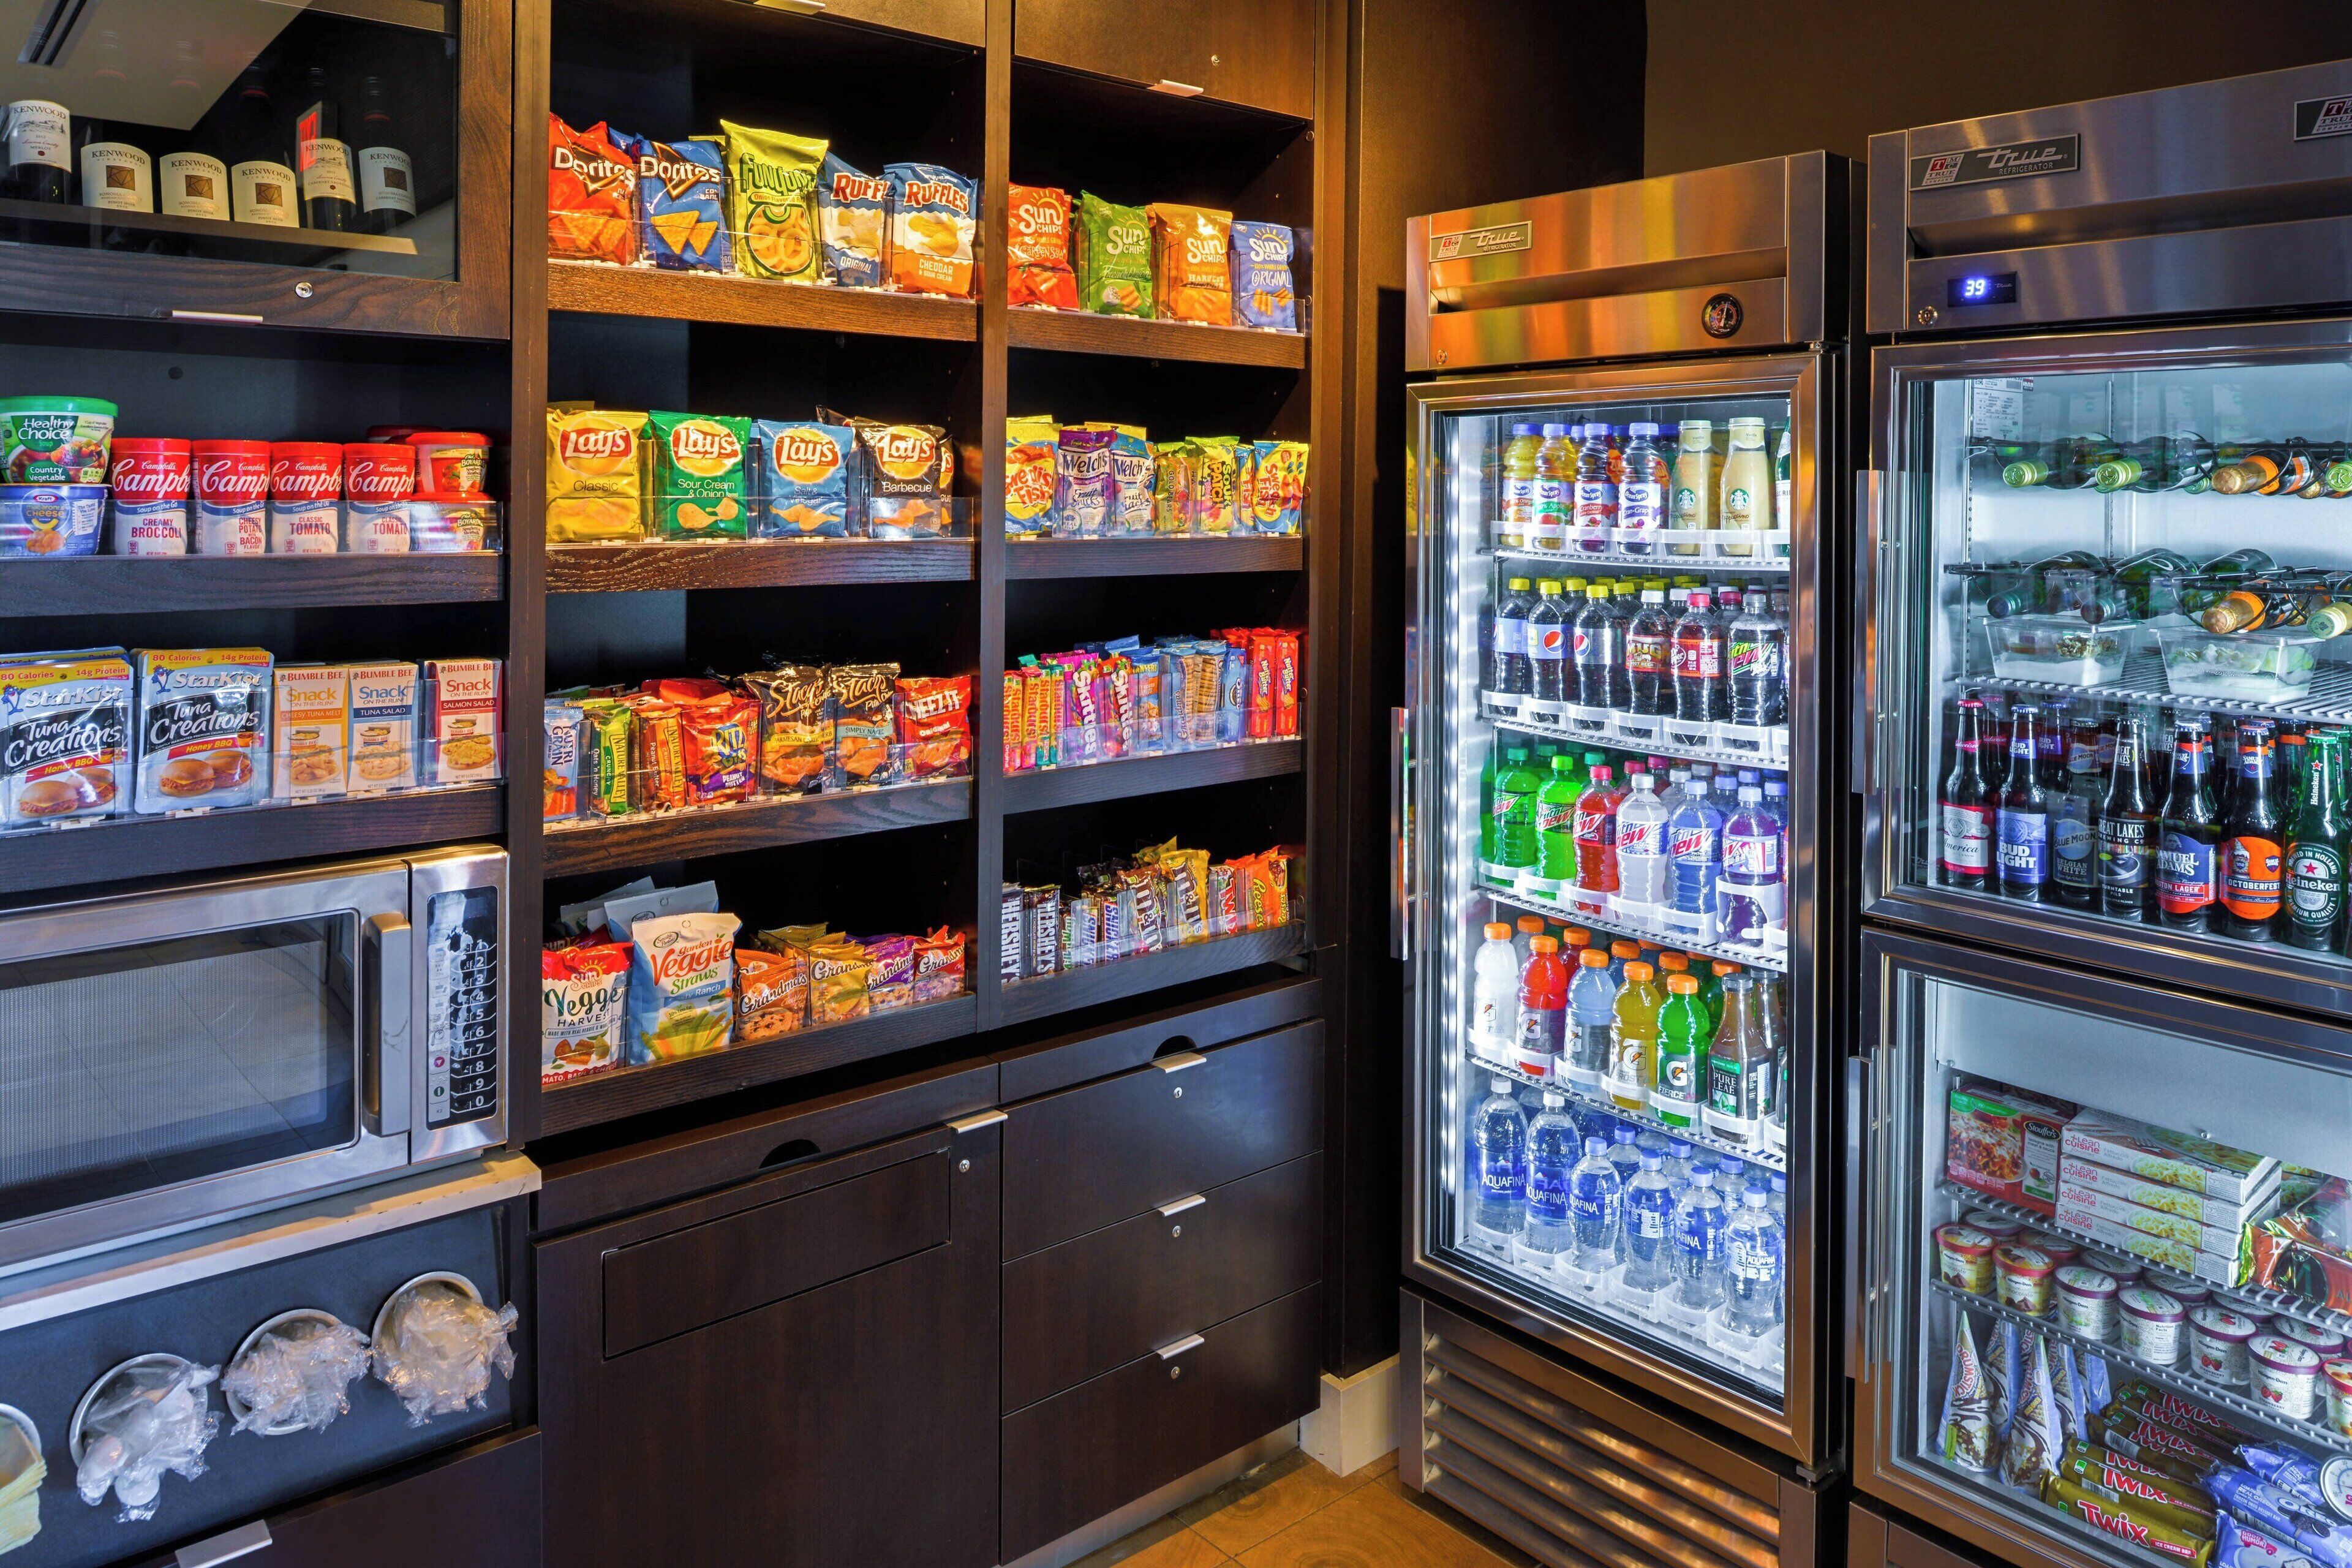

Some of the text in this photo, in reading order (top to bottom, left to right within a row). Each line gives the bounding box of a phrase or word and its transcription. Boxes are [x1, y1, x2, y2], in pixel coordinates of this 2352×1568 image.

[14, 105, 66, 119] KENWOOD
[92, 150, 145, 164] KENWOOD
[172, 160, 222, 175] KENWOOD
[242, 169, 290, 181] KENWOOD
[554, 146, 635, 190] Doritos
[641, 156, 721, 183] Doritos
[1999, 162, 2052, 175] REFRIGERATOR
[905, 181, 969, 213] RUFFLES
[1019, 204, 1061, 234] Sun
[1036, 224, 1061, 233] CHIPS
[1106, 225, 1146, 255] Sun
[1188, 237, 1224, 264] Sun
[1249, 235, 1286, 262] Sun
[1202, 254, 1225, 263] CHIPS
[1265, 252, 1288, 261] CHIPS
[840, 257, 872, 273] ORIGINAL
[919, 259, 953, 275] CHEDDAR
[1965, 279, 1985, 296] 39
[23, 416, 75, 430] Healthy
[18, 427, 70, 439] Choice
[565, 428, 627, 459] Lay's
[678, 426, 740, 459] Lay's
[883, 434, 932, 463] Lay's
[780, 435, 834, 466] Lay's
[1061, 452, 1107, 473] Welch's
[573, 480, 619, 491] Classic
[678, 479, 734, 489] Sour Cream
[794, 486, 811, 495] Salt
[883, 482, 932, 492] Barbecue
[696, 489, 724, 497] Onion
[1635, 491, 1649, 500] Spray
[132, 527, 181, 538] BROCCOLI
[290, 523, 330, 535] TOMATO
[18, 671, 55, 680] Calories
[76, 666, 126, 677] 14g Protein
[360, 670, 397, 679] BUMBLE
[448, 664, 482, 673] BUMBLE
[173, 671, 263, 689] StarKist
[288, 672, 325, 681] BUMBLE
[359, 685, 407, 699] Snack
[446, 679, 492, 693] Snack
[24, 685, 123, 707] StarKist
[286, 687, 336, 702] Snack
[165, 701, 211, 717] Tuna
[1073, 670, 1097, 755] Skittles
[1111, 670, 1133, 751] Skittles
[20, 720, 69, 741] Tuna
[151, 709, 260, 745] Creations
[4, 723, 121, 767] Creations
[186, 739, 232, 754] Honey BBQ
[552, 726, 563, 766] GRAIN
[563, 726, 575, 764] NUTRI
[711, 726, 745, 753] RITZ
[43, 761, 72, 775] Honey
[74, 758, 93, 768] BBQ
[615, 737, 625, 801] NATURE VALLEY
[723, 772, 742, 783] PEANUT
[2310, 770, 2320, 805] Heineken
[2117, 822, 2144, 838] LAKES
[1943, 837, 1979, 853] America
[2054, 832, 2097, 848] BLUE MOON
[2000, 842, 2030, 856] BUD
[2156, 846, 2199, 865] SAMUEL
[1997, 856, 2036, 869] LIGHT
[2057, 859, 2087, 869] BELGIAN
[2157, 859, 2195, 876] ADAMS
[2315, 853, 2337, 874] HOLLAND
[2057, 865, 2087, 876] WHITE
[2228, 878, 2280, 889] OCTOBERFEST
[2286, 872, 2340, 891] Heineken
[2102, 885, 2133, 894] TURNTABLE
[1220, 878, 1237, 935] TWIX
[1253, 878, 1266, 927] Reese's
[1037, 903, 1055, 974] HERSHEY'S
[679, 941, 712, 956] garden
[476, 957, 484, 967] 2
[650, 938, 734, 987] Veggie
[476, 974, 484, 984] 3
[671, 969, 718, 995] Straws
[475, 992, 484, 1001] 4
[696, 984, 720, 995] Ranch
[740, 974, 807, 1016] Grandma's
[476, 1009, 483, 1020] 5
[557, 1009, 611, 1027] HARVEST
[476, 1027, 484, 1037] 6
[476, 1044, 484, 1054] 7
[475, 1061, 484, 1072] 8
[1667, 1061, 1688, 1087] G
[475, 1078, 483, 1089] 9
[1713, 1073, 1736, 1086] PURE
[1658, 1084, 1685, 1099] FIERCE
[1714, 1082, 1735, 1094] LEAF
[475, 1096, 484, 1106] 0
[2028, 1123, 2057, 1138] Stouffer's
[2078, 1137, 2100, 1148] Lean
[2076, 1164, 2097, 1175] Lean
[1482, 1174, 1525, 1189] AQUAFINA
[2075, 1189, 2096, 1199] Lean
[2071, 1210, 2092, 1222] Lean
[2278, 1498, 2337, 1528] OREO
[2242, 1531, 2262, 1541] GOOD
[2242, 1534, 2266, 1548] HUMOR
[2164, 1544, 2180, 1552] CREAM
